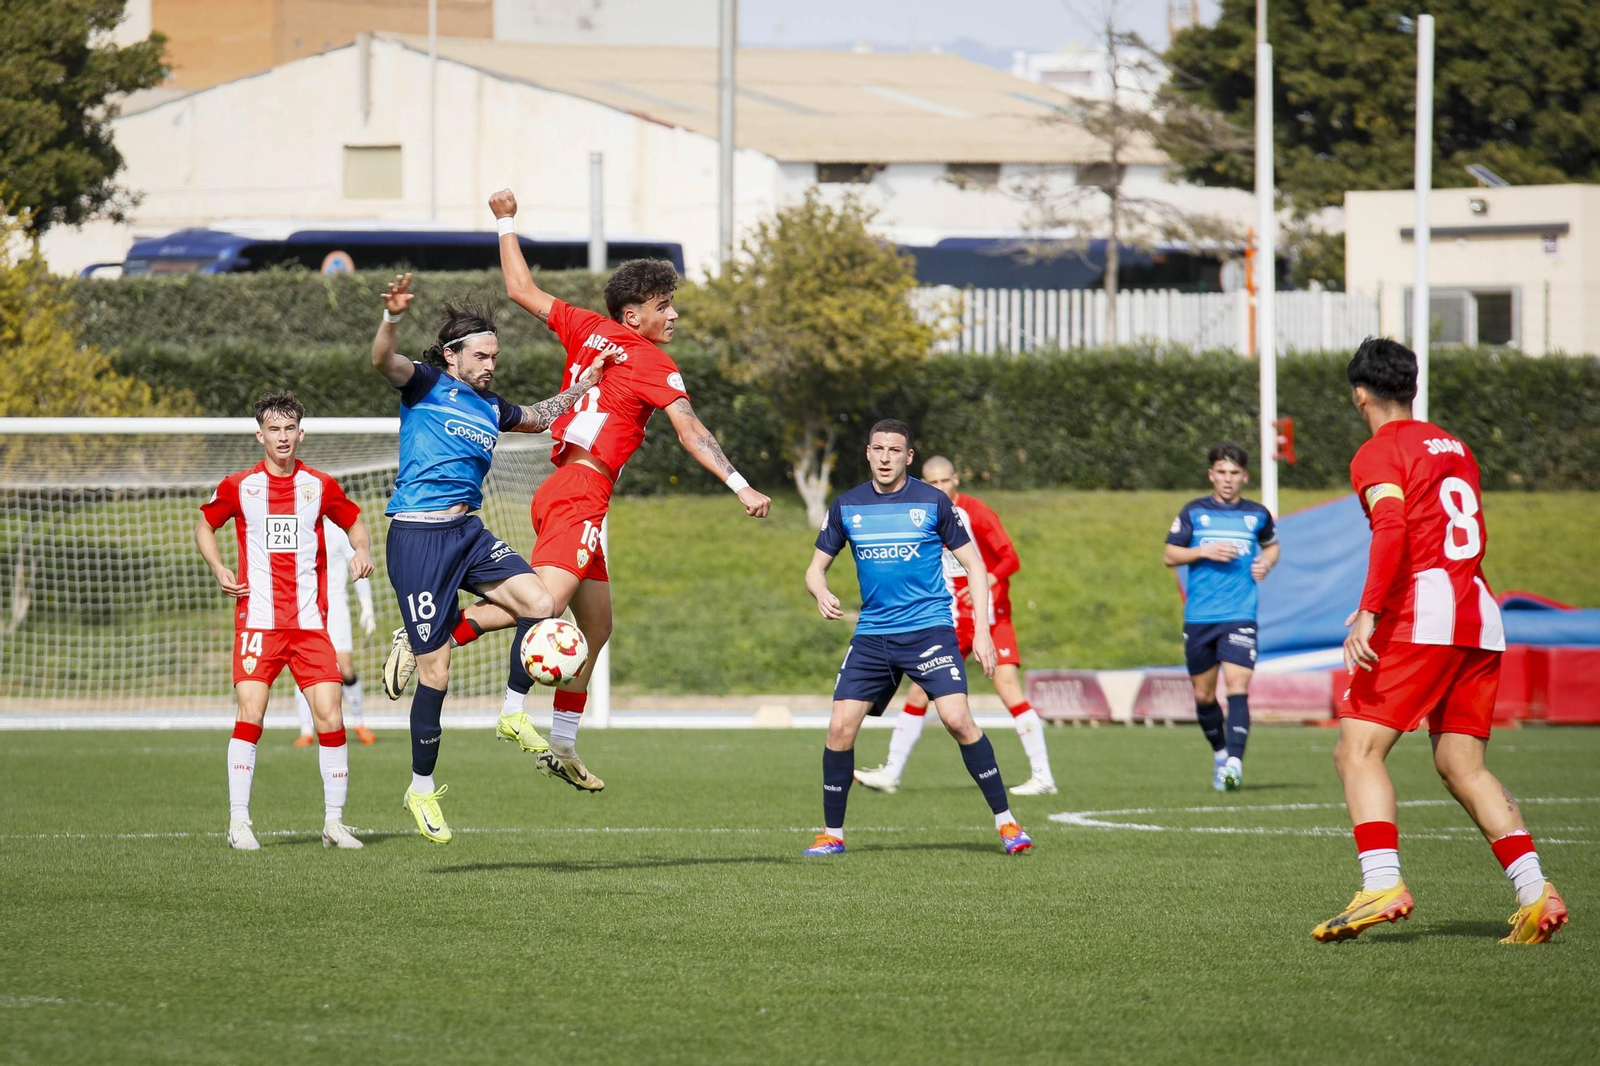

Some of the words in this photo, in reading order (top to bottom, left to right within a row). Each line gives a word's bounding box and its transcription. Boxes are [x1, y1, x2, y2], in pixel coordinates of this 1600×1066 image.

[1423, 438, 1465, 457] JOAN
[1439, 476, 1481, 561] 8
[580, 519, 599, 553] 16
[407, 591, 437, 622] 18
[240, 631, 263, 657] 14
